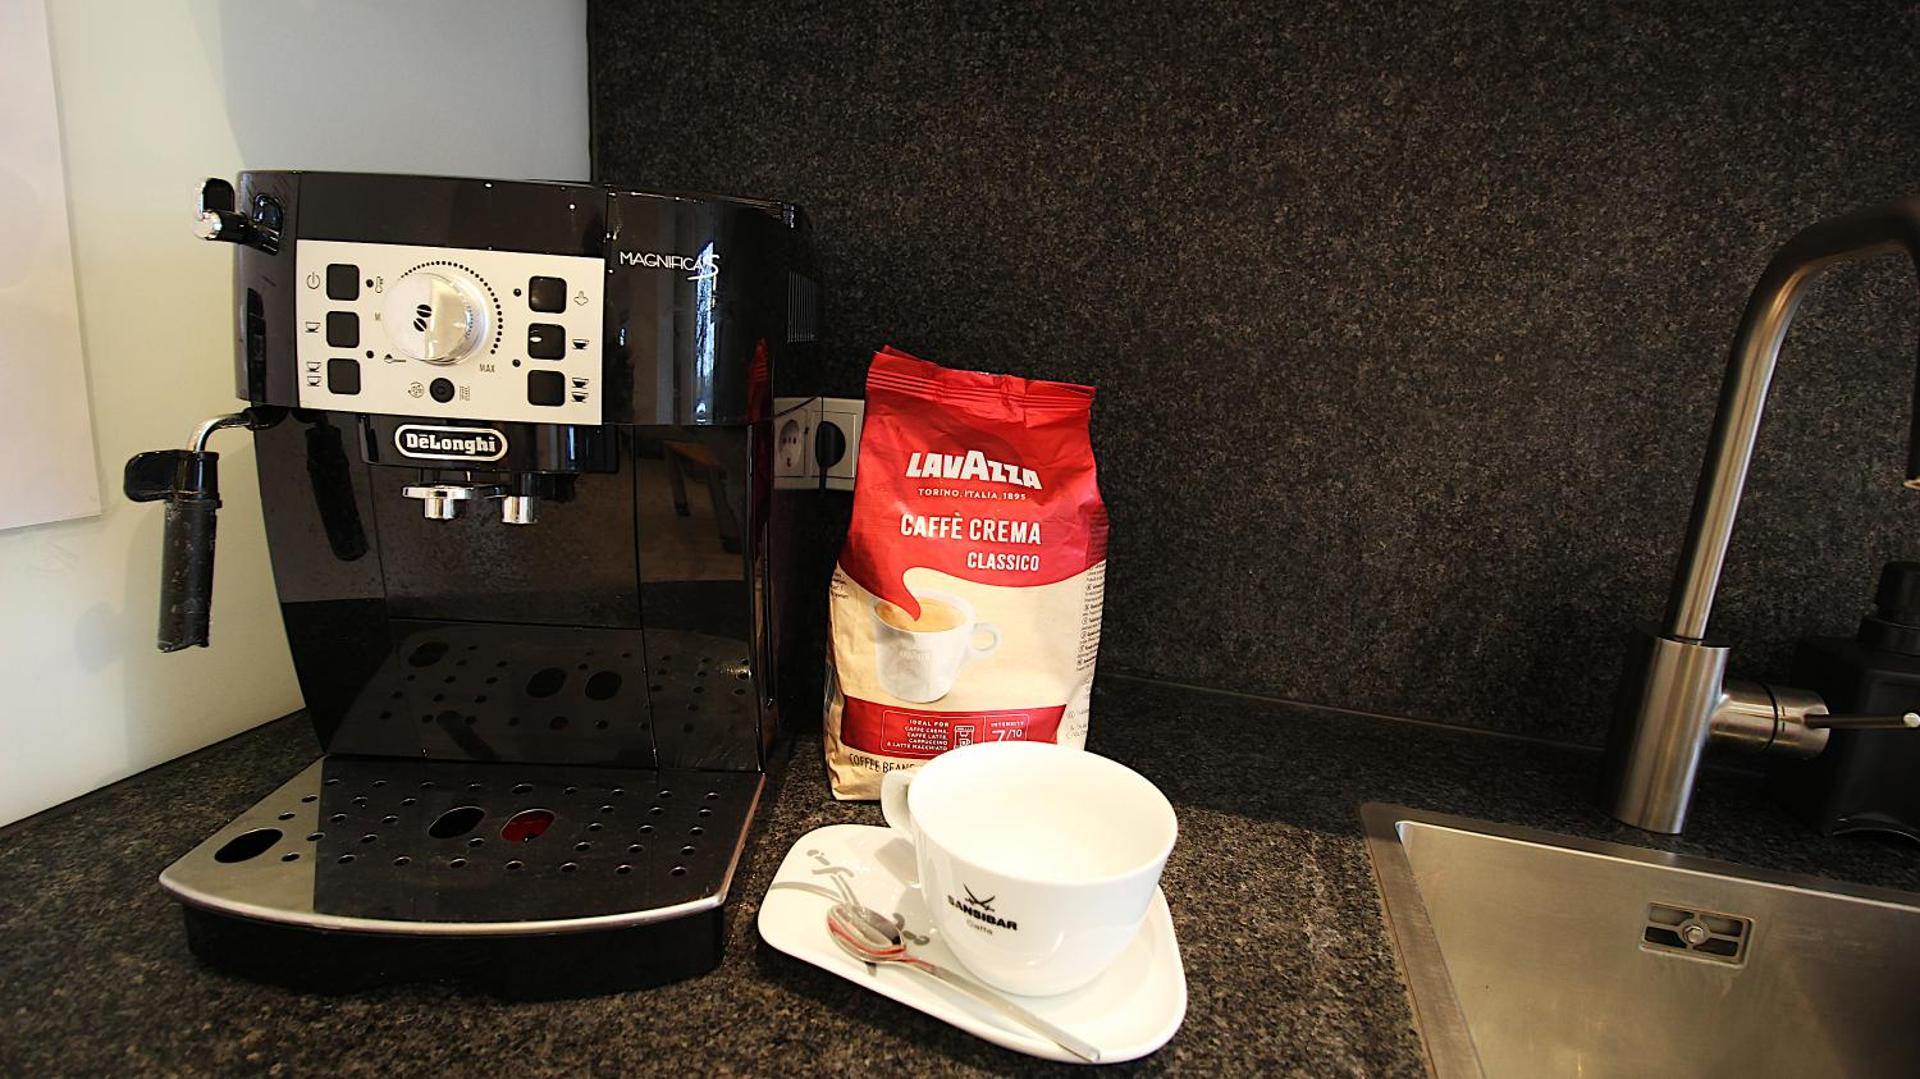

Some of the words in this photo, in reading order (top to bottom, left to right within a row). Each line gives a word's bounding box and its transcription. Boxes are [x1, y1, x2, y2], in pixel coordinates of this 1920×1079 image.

[619, 251, 704, 272] MAGNIFICA
[479, 364, 495, 373] MAX
[905, 450, 1043, 490] LAVAZZA
[1003, 492, 1026, 501] 1895
[900, 512, 963, 540] CAFFÈ
[969, 518, 1041, 545] CREMA
[967, 552, 1040, 572] CLASSICO
[849, 753, 880, 773] COFFEE
[947, 895, 1018, 931] SANSIBAR
